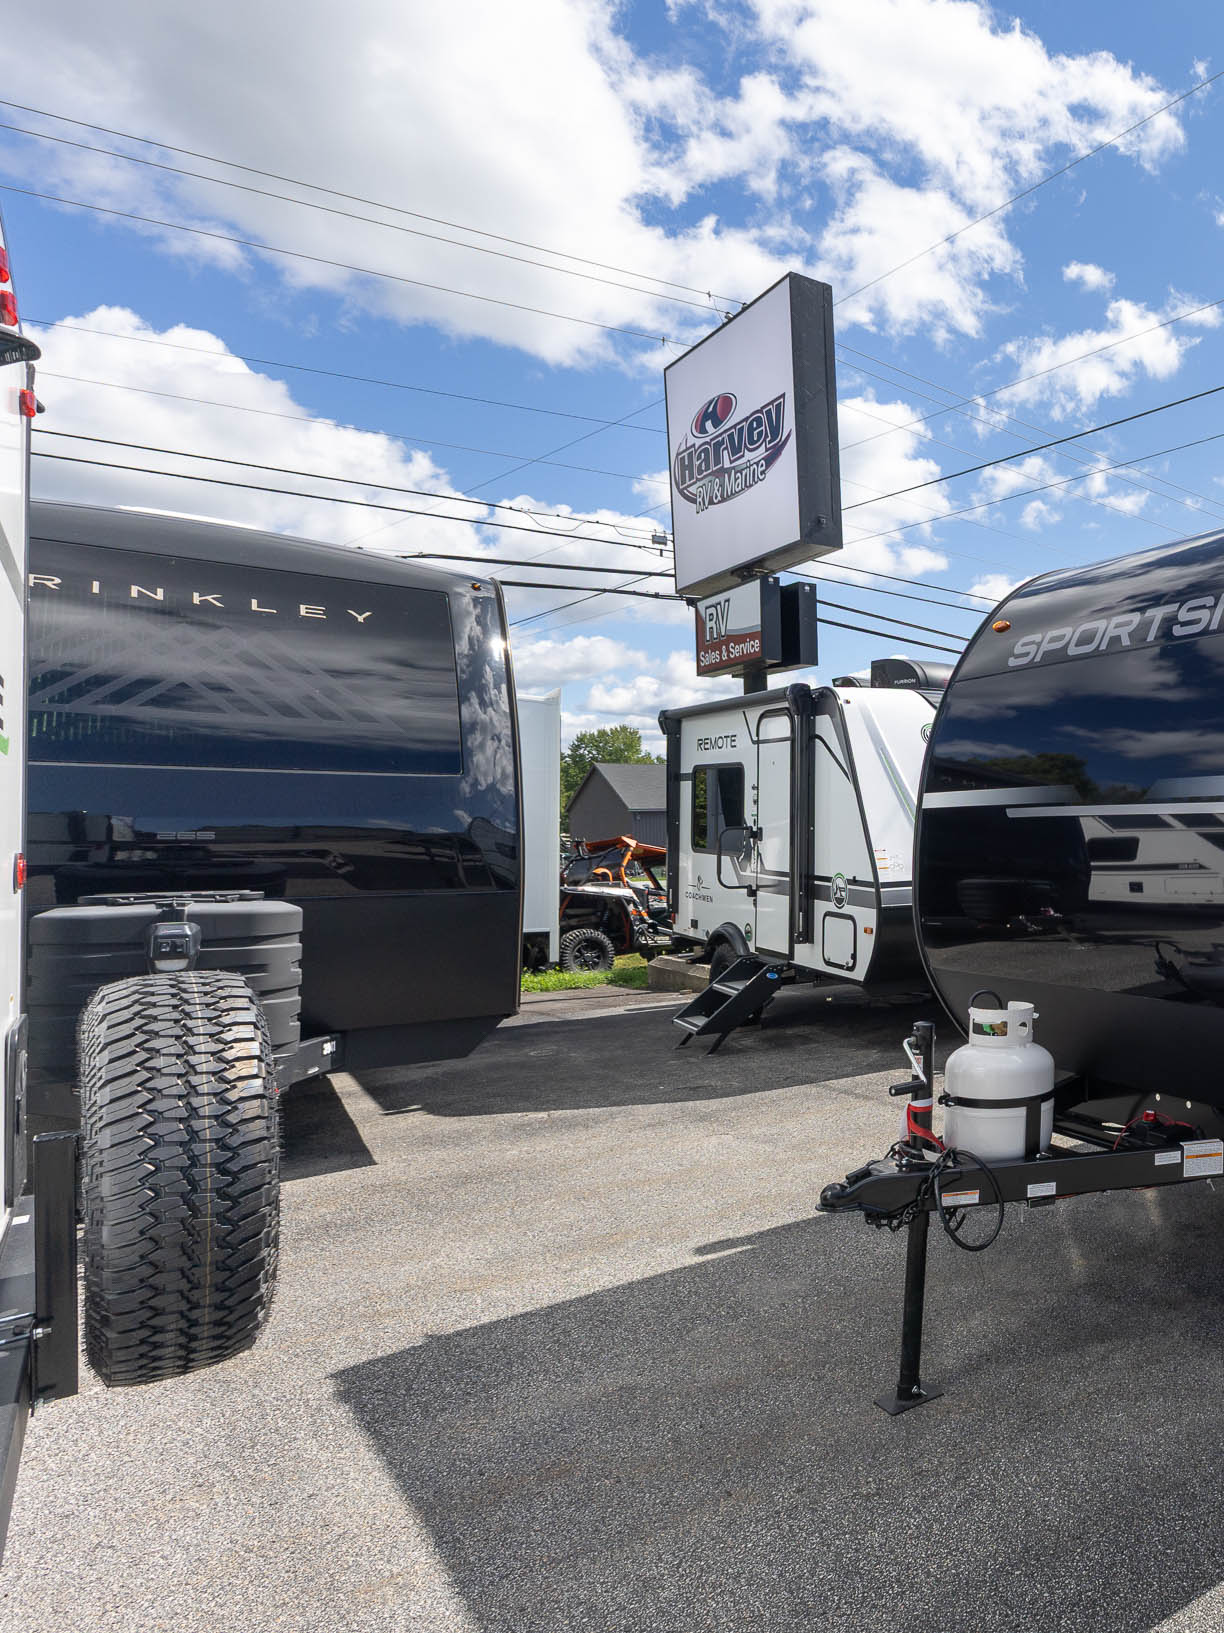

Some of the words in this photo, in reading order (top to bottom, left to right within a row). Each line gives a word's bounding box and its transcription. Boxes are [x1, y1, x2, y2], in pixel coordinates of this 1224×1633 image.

[679, 396, 784, 488] Harvey
[696, 482, 711, 514] RV
[713, 478, 723, 503] &
[724, 458, 767, 499] Marine
[705, 598, 730, 643] RV
[700, 650, 720, 666] Sales
[722, 645, 728, 661] &
[729, 638, 760, 658] Service
[697, 734, 737, 751] REMOTE
